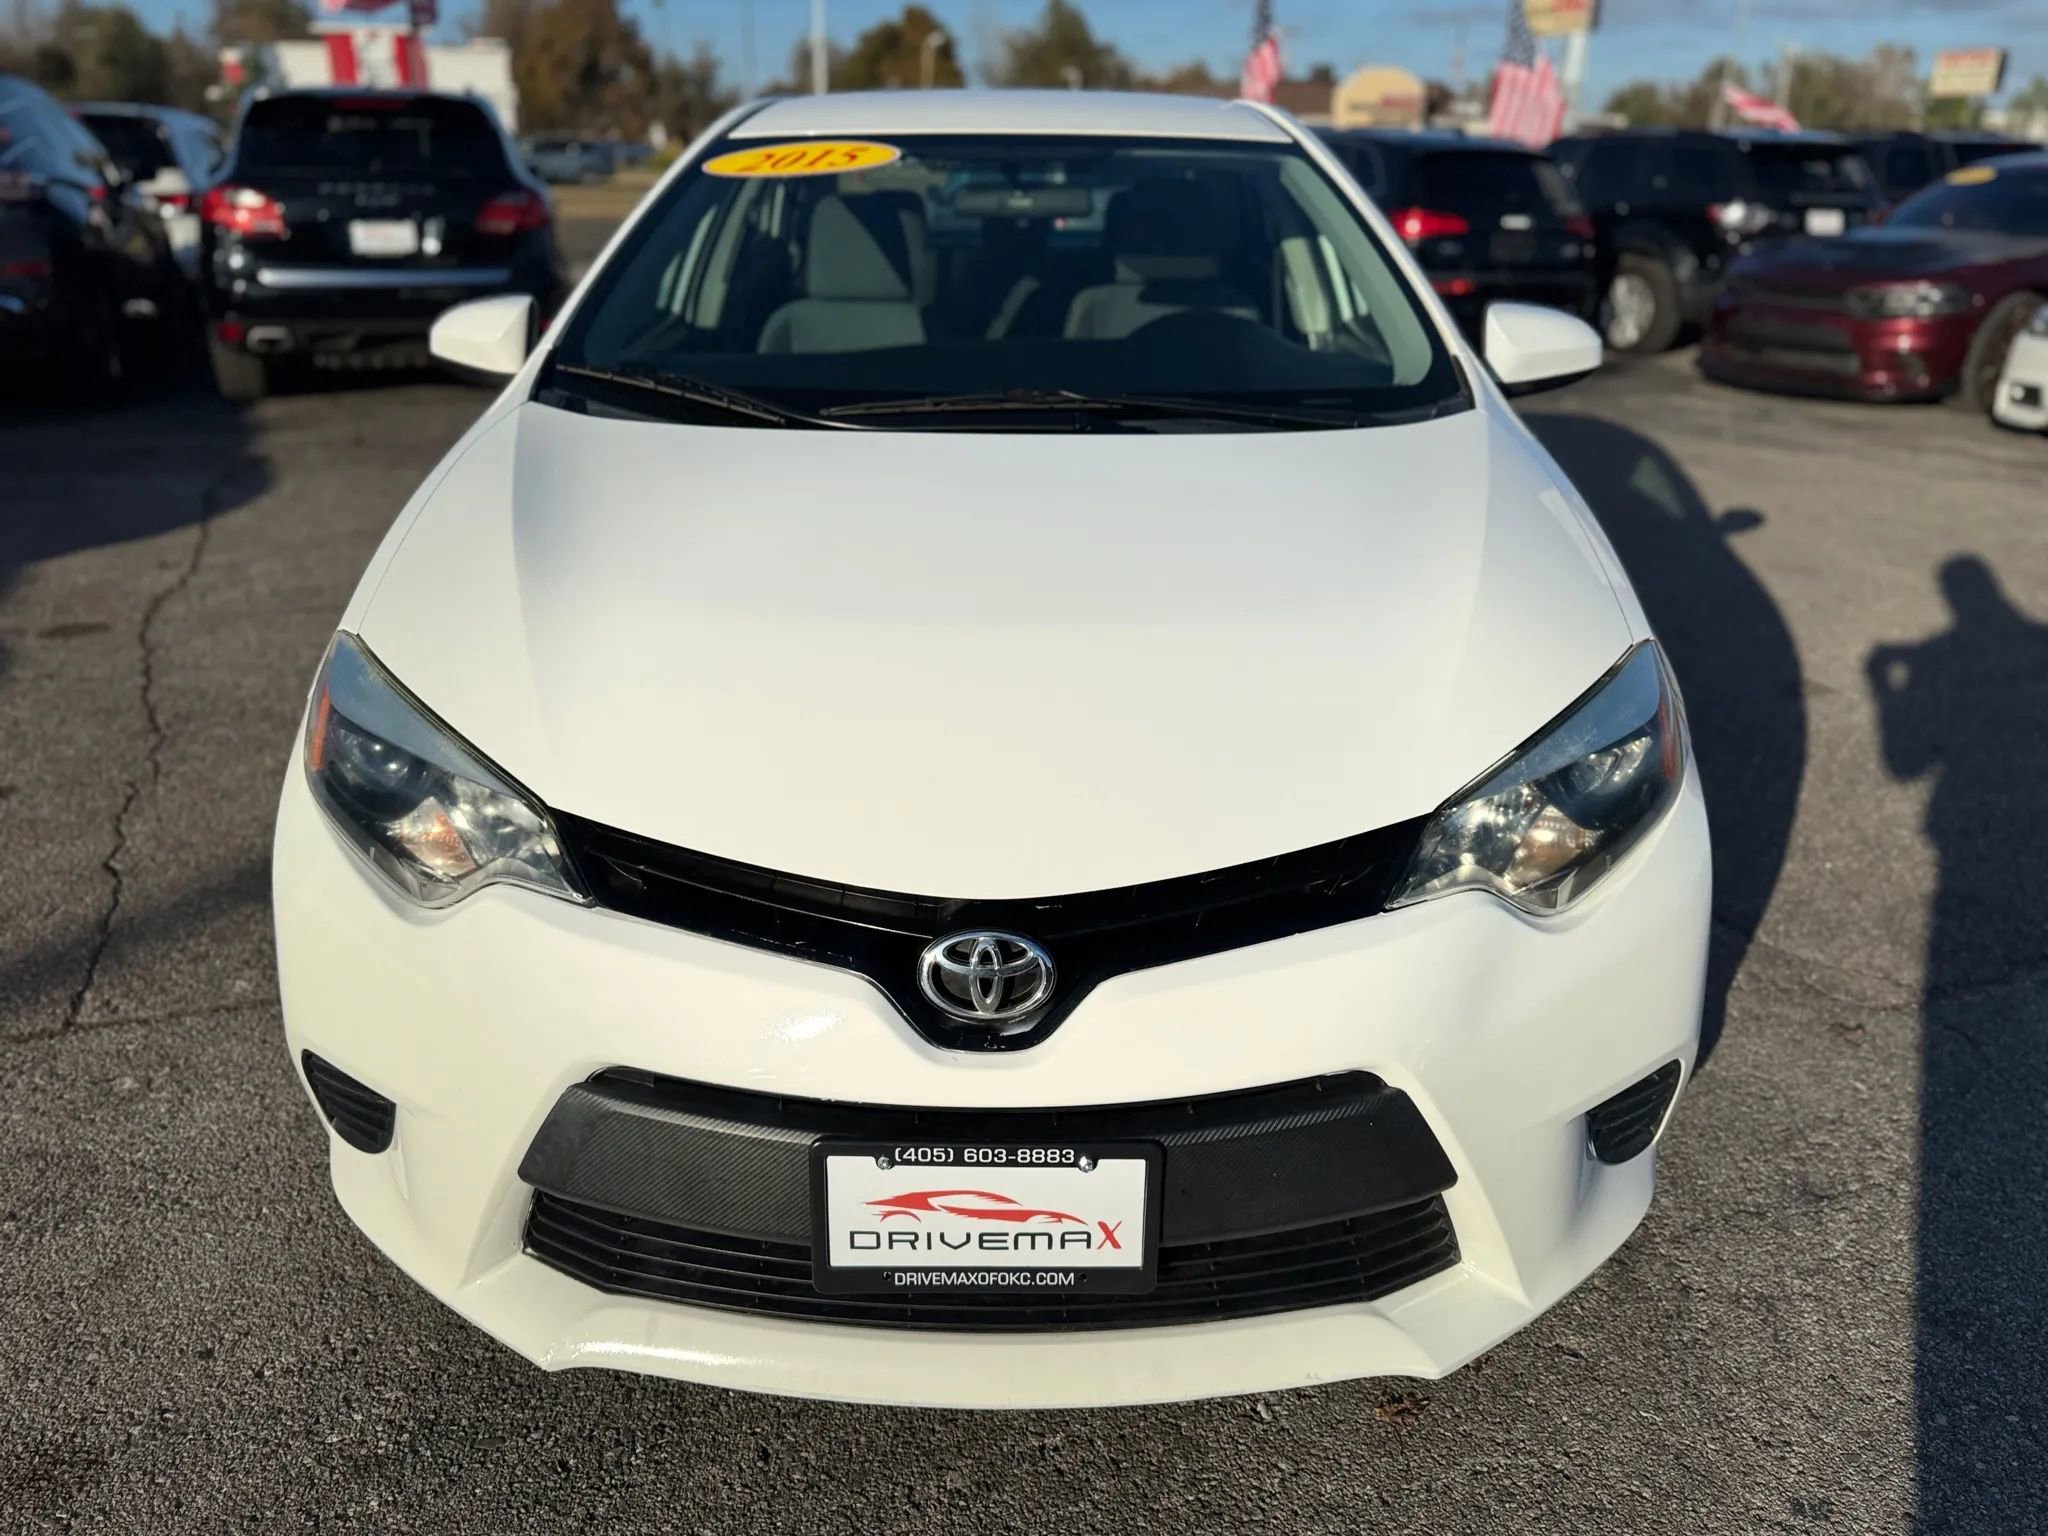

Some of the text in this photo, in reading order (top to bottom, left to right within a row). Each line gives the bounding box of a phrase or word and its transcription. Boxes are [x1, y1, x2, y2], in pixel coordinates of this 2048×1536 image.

[736, 147, 871, 173] 2015
[894, 1147, 1075, 1164] (405) 603-8883
[849, 1220, 1122, 1251] DRIVEMAX
[894, 1272, 1075, 1286] DRIVEMAXOFOKC.COM
